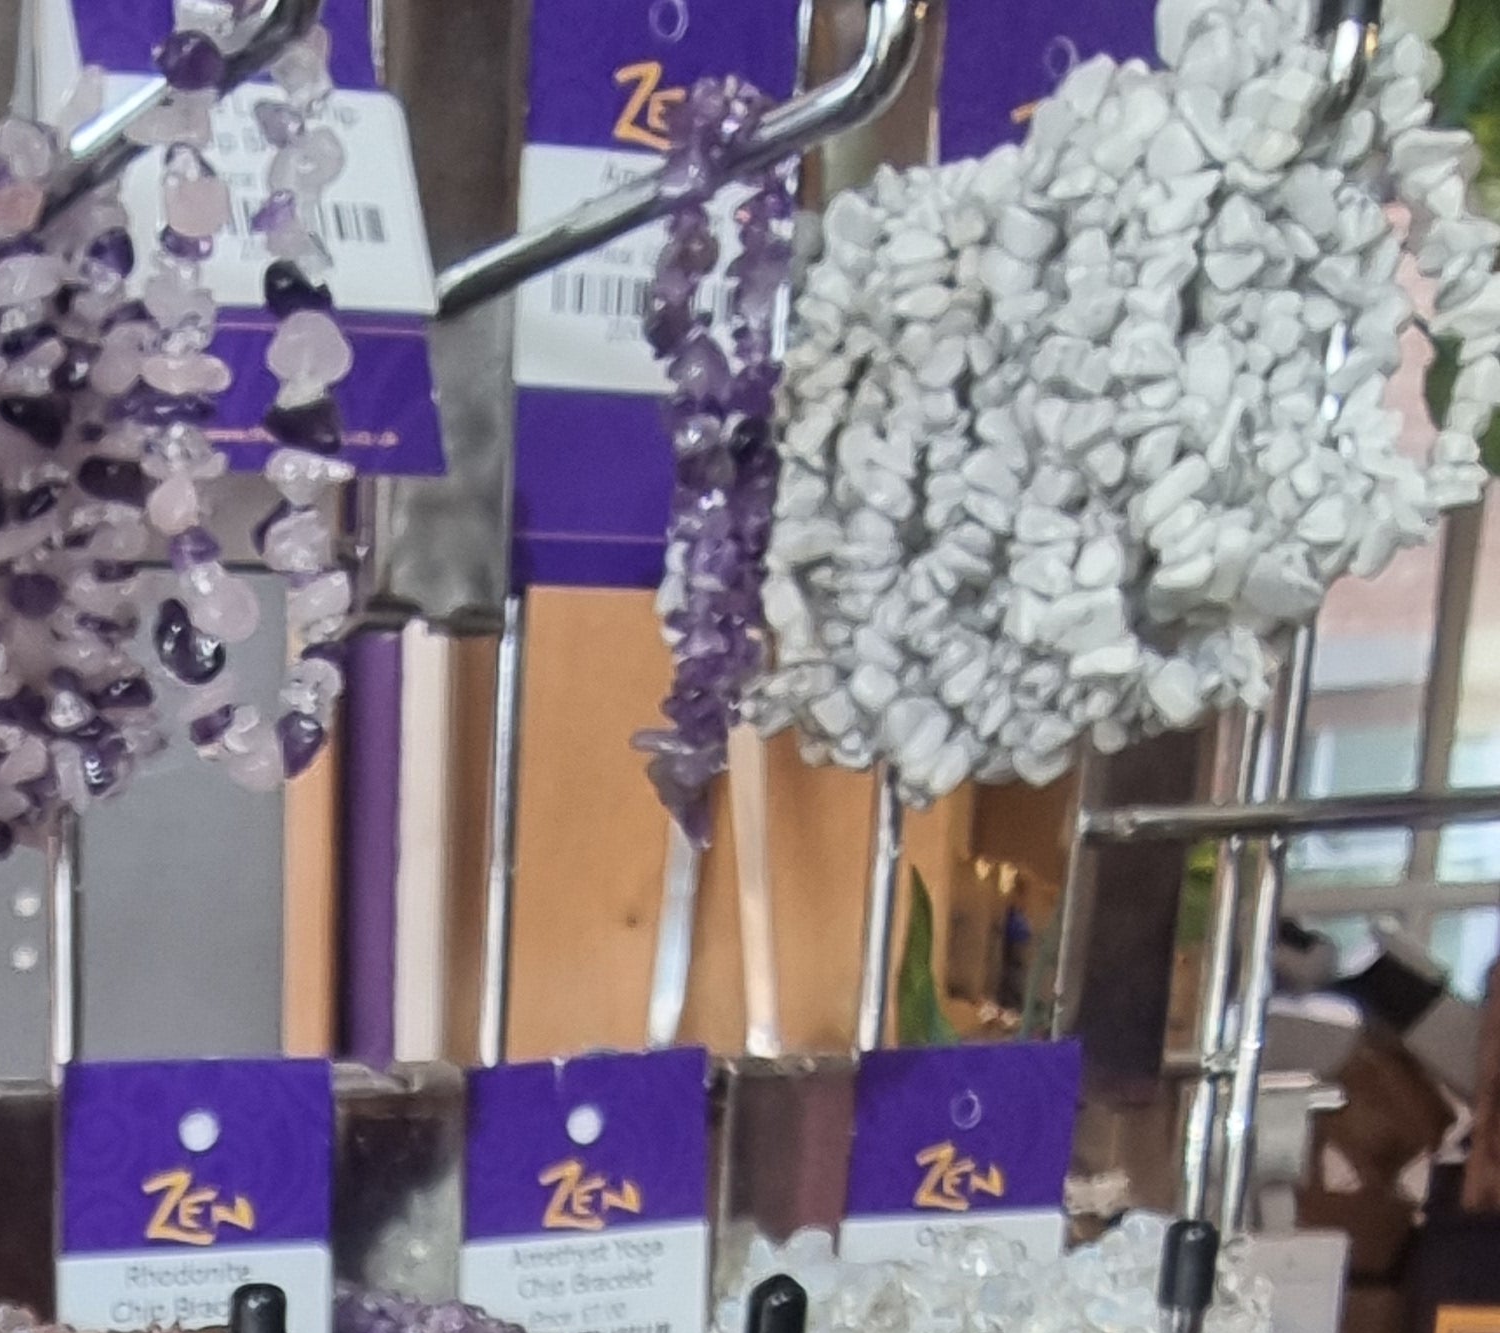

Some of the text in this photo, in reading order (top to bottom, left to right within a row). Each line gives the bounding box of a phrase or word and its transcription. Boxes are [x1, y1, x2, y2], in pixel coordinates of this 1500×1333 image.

[612, 60, 686, 150] ZE
[141, 1170, 256, 1246] ZEN
[538, 1158, 643, 1231] ZEN
[913, 1140, 1004, 1212] ZEN
[124, 1260, 251, 1289] Rhodonite
